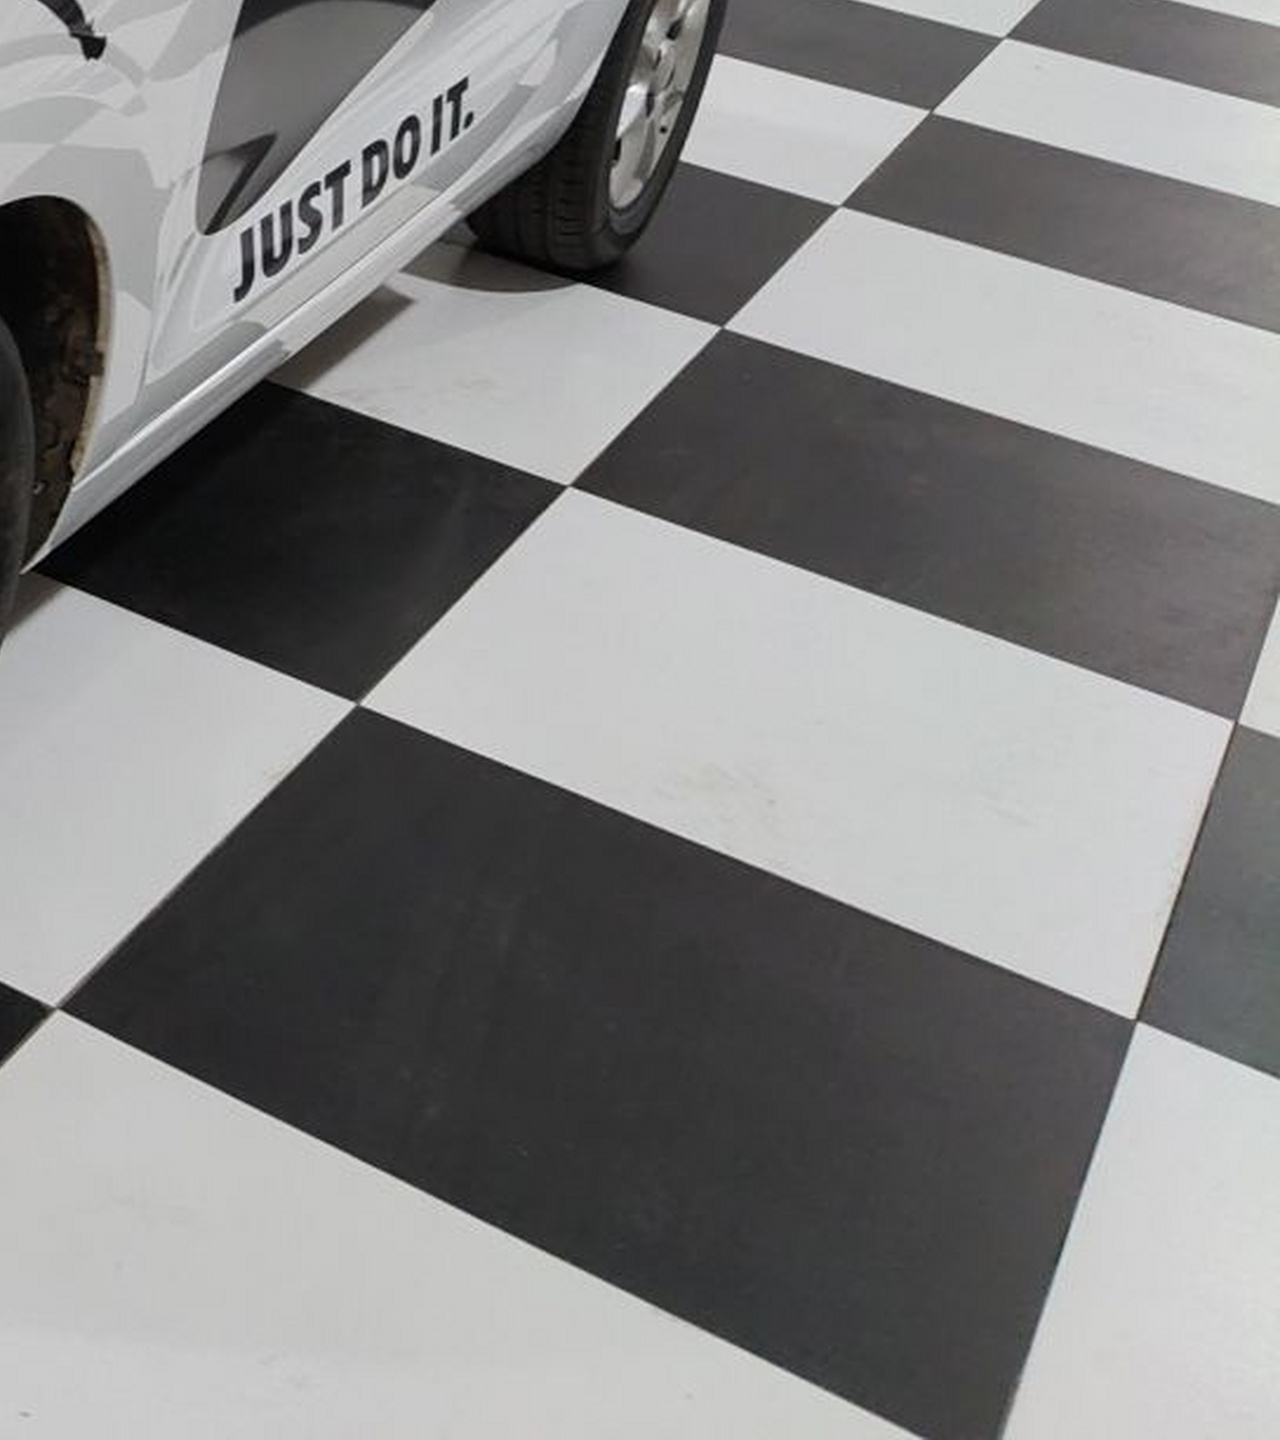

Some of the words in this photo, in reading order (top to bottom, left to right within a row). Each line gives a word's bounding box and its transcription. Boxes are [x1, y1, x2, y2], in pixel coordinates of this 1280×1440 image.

[233, 159, 351, 304] JUST
[361, 114, 421, 210] DO
[430, 76, 475, 157] IT.
